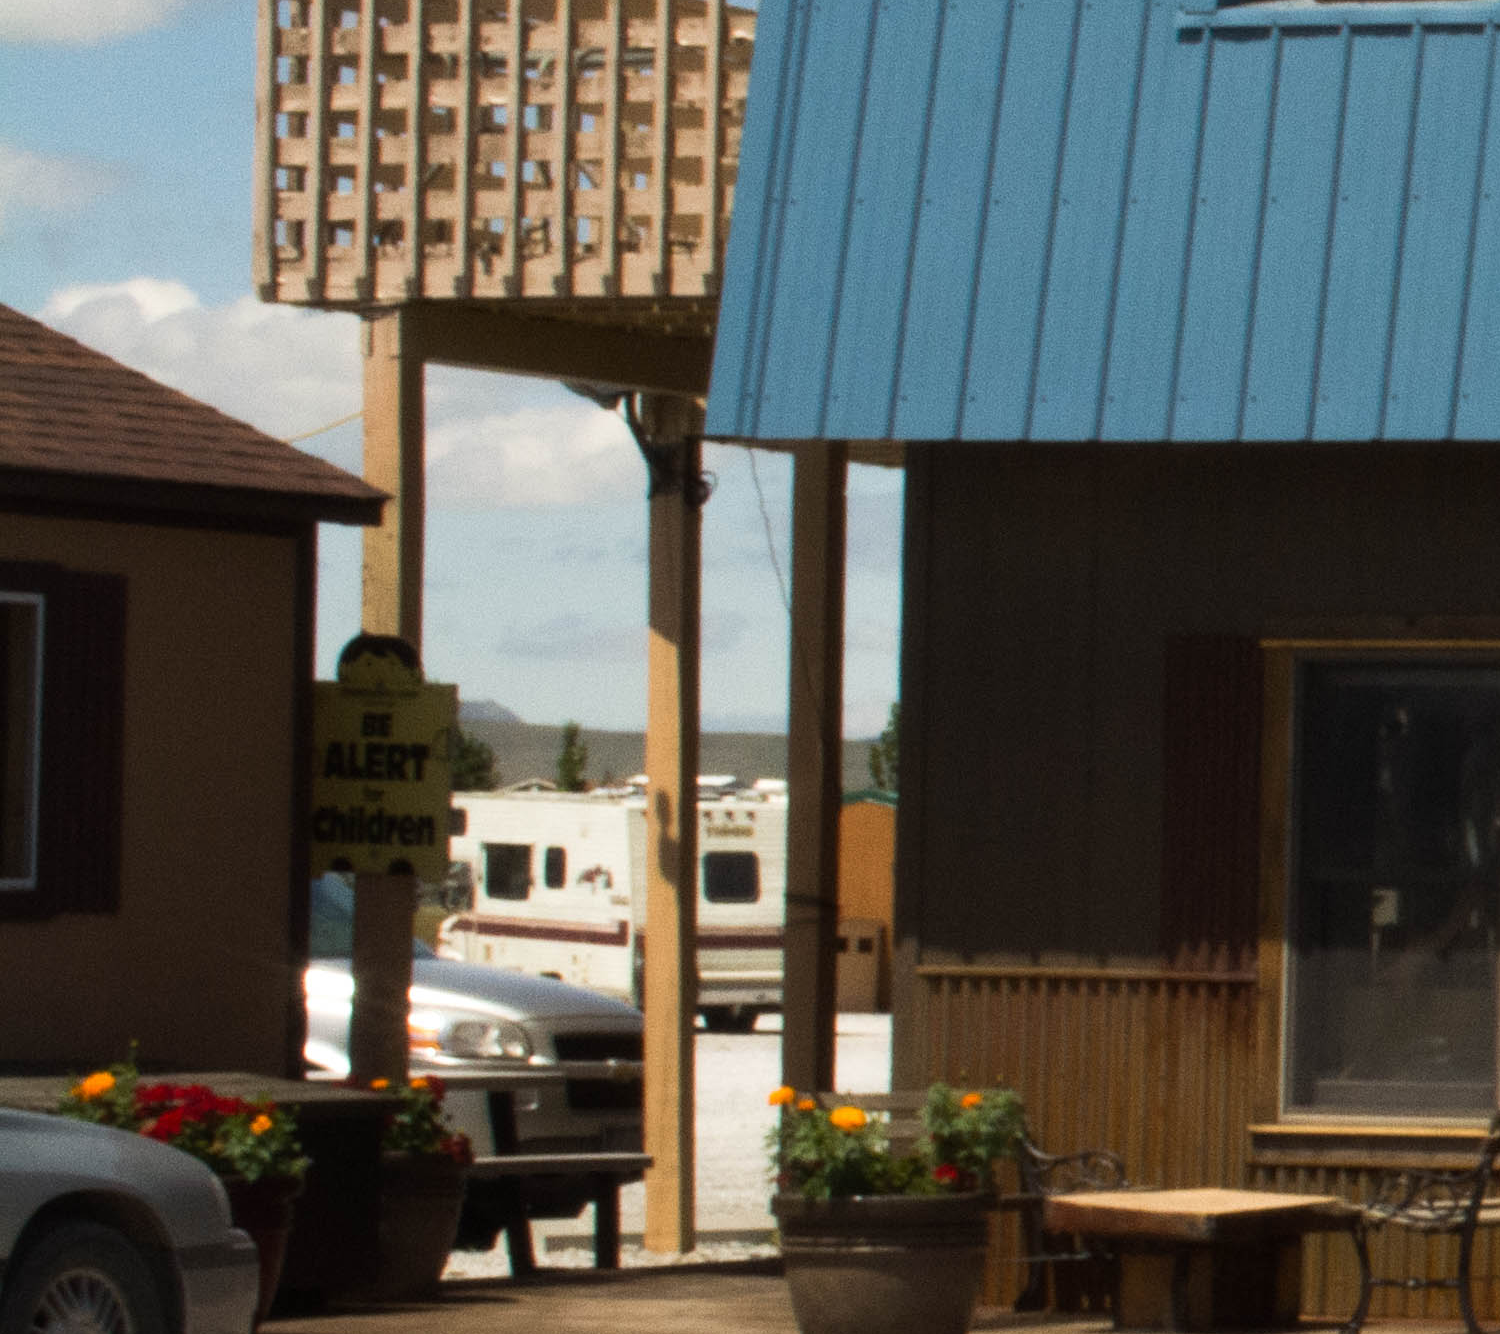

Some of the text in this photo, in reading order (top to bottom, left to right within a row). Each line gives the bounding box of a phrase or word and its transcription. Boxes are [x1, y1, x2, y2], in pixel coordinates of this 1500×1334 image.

[362, 713, 393, 736] BE
[324, 742, 430, 780] ALERT
[313, 805, 436, 847] Children
